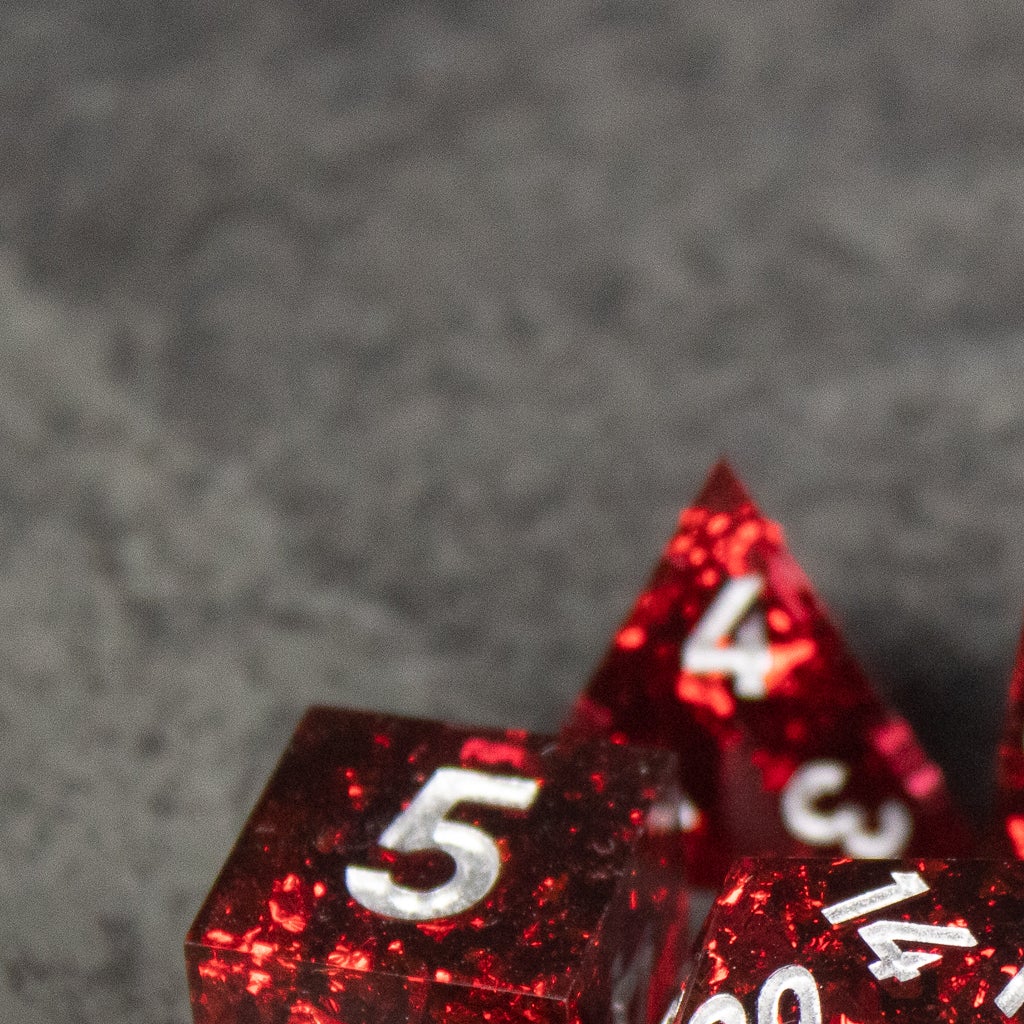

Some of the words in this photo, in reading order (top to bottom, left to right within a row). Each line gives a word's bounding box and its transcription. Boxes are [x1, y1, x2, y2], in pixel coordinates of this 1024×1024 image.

[682, 574, 775, 698] 4
[345, 766, 540, 921] 5
[782, 761, 913, 859] 3
[821, 871, 979, 983] 14
